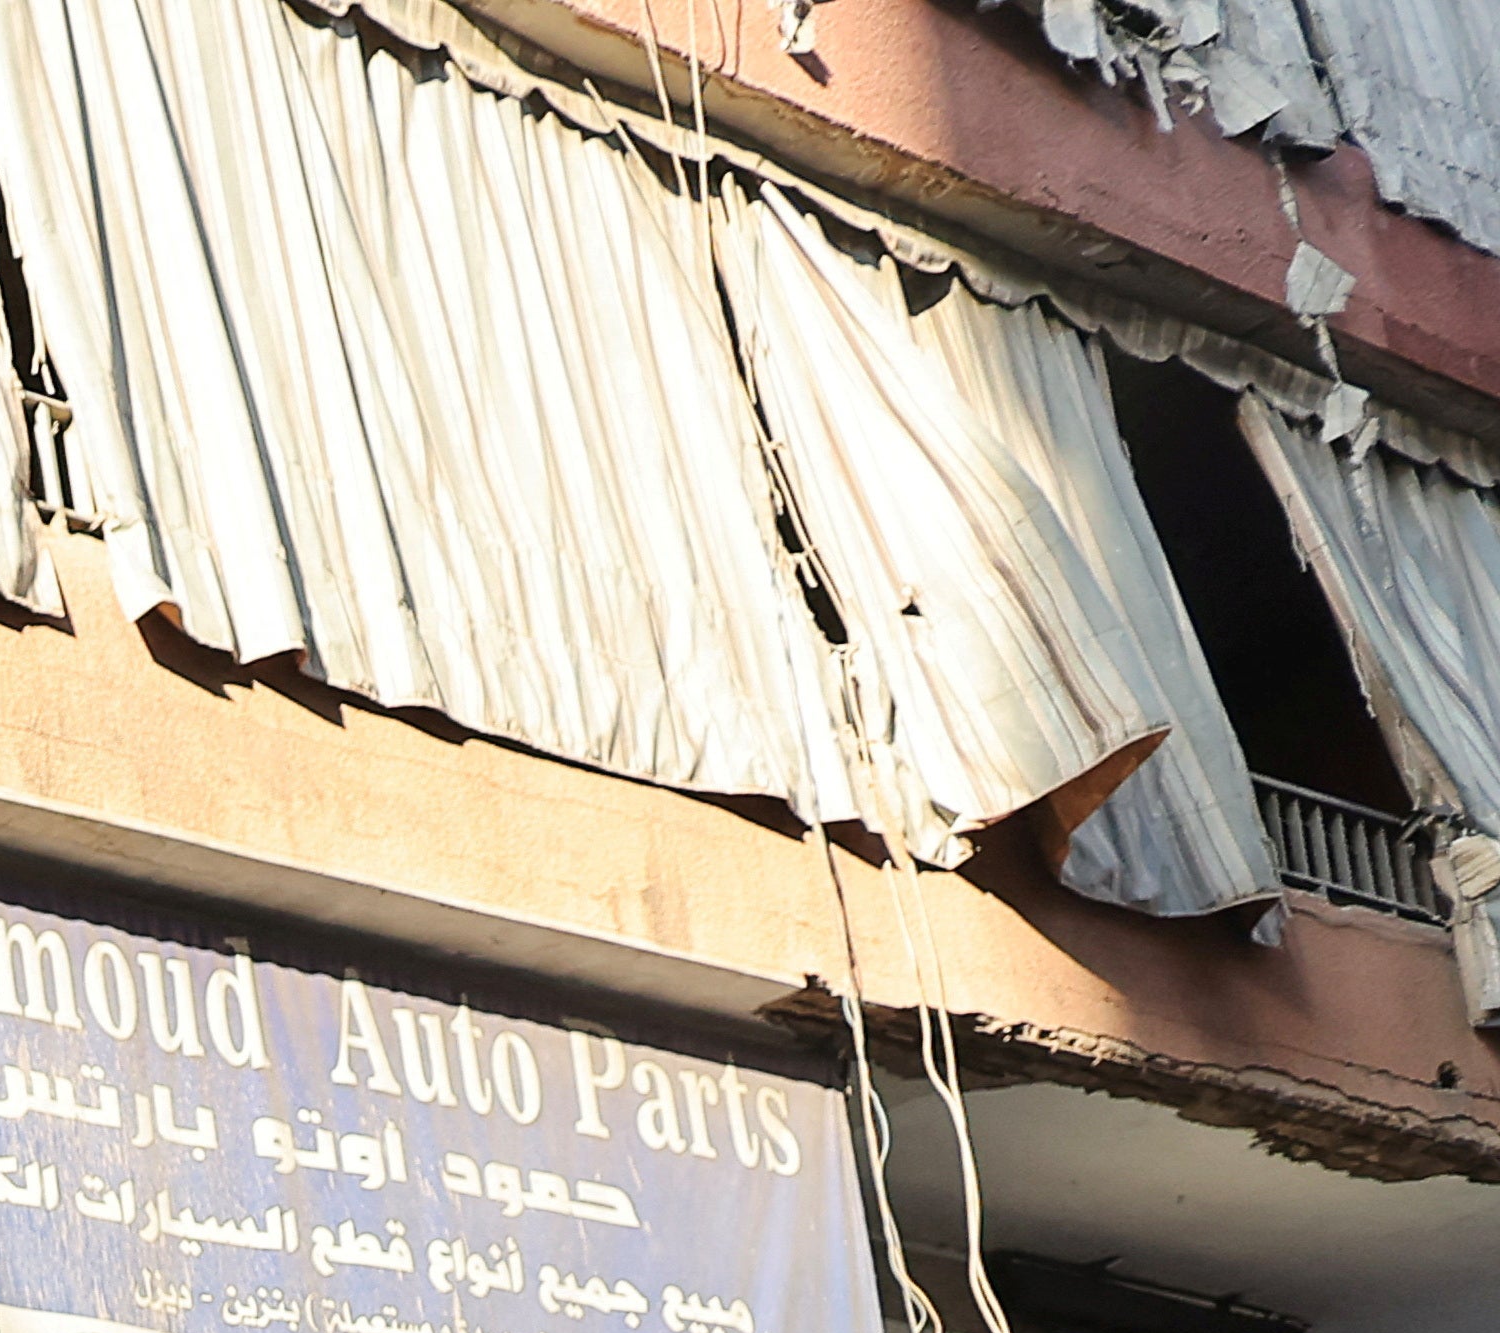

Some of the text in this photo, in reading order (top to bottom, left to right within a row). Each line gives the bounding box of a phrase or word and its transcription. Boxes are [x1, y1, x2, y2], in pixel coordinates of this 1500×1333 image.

[331, 970, 543, 1125] Auto
[562, 1017, 801, 1177] Parts
[252, 1107, 408, 1190] اوتو
[75, 1174, 299, 1257] السيارات
[442, 1151, 640, 1228] حمود
[310, 1218, 414, 1278] قطع
[426, 1235, 525, 1298] أنواع
[538, 1264, 649, 1329] جميع
